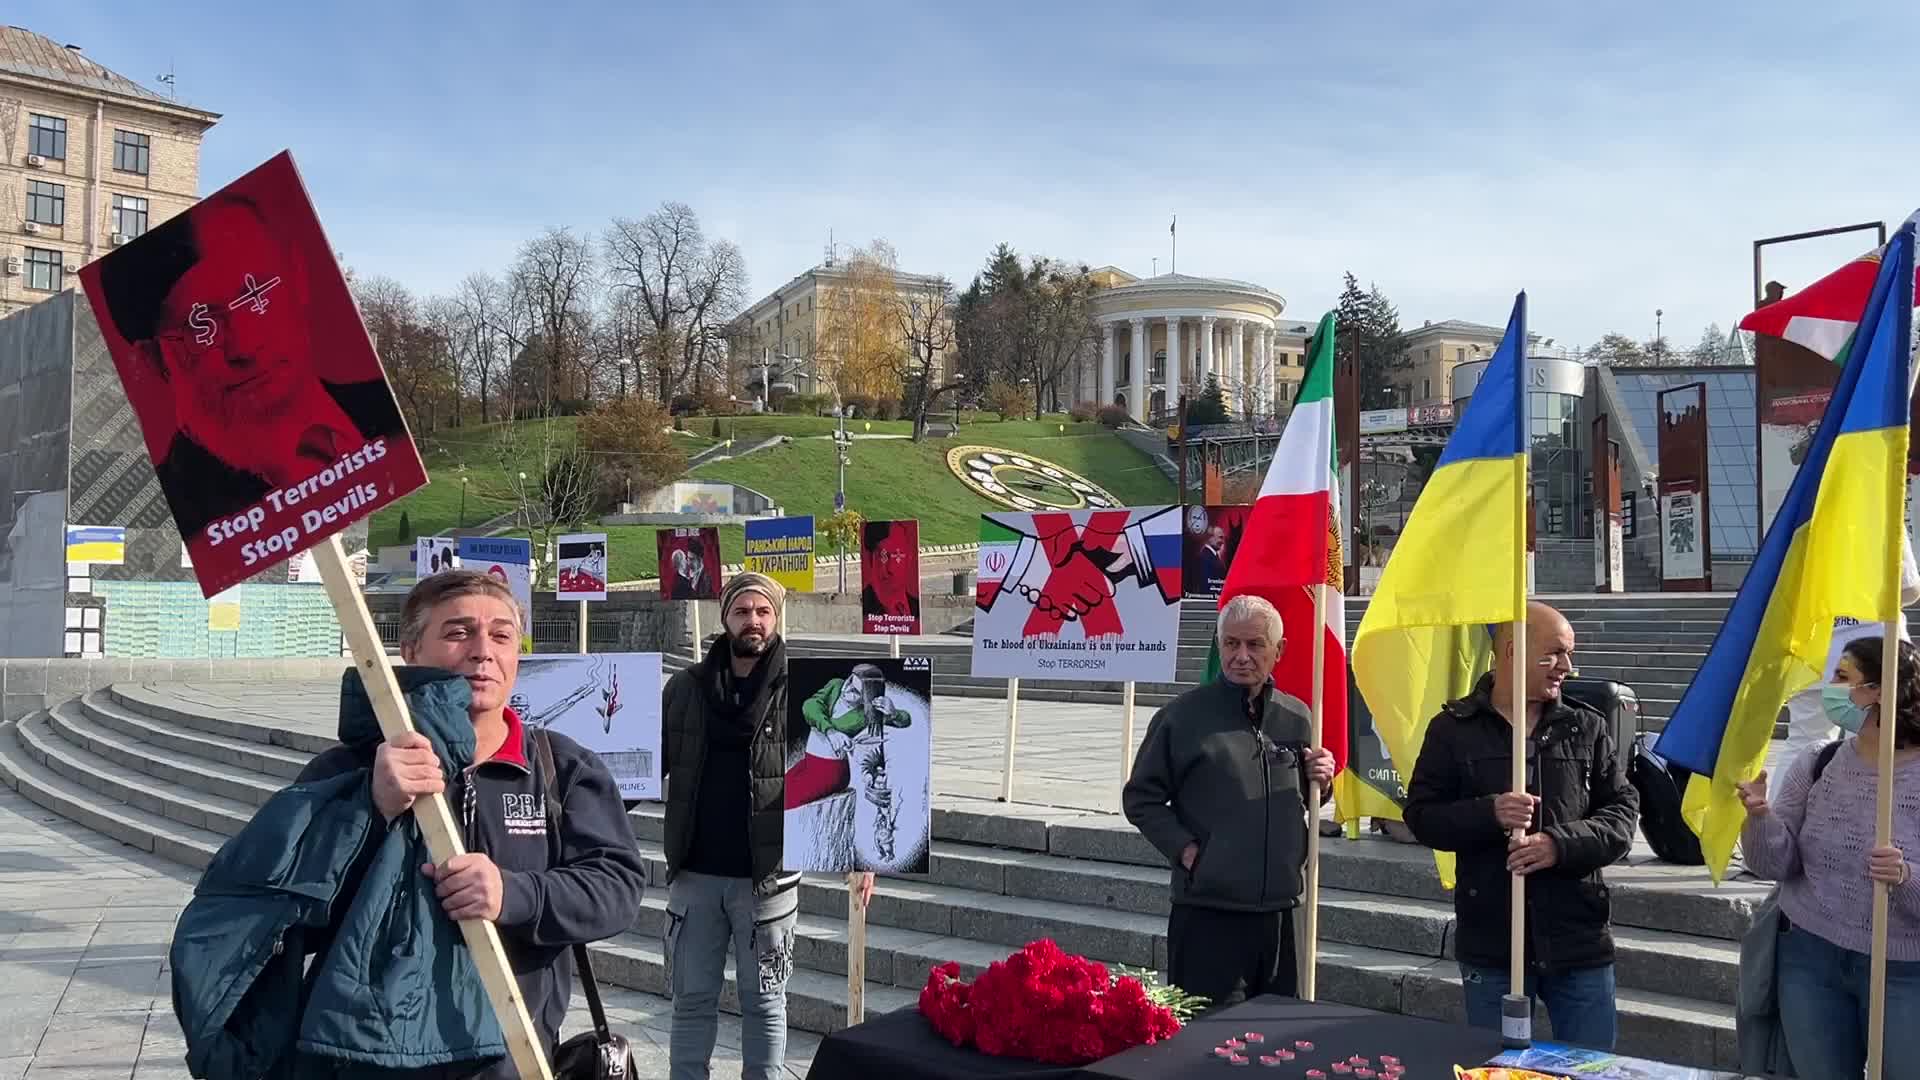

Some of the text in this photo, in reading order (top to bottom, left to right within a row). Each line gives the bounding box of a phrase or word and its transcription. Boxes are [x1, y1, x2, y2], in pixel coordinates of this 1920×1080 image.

[207, 439, 387, 546] Stop Terrorists
[241, 482, 378, 566] Stop Devils
[868, 613, 915, 623] Stop Terrorists
[873, 624, 910, 632] Stop Devils
[983, 638, 1167, 654] The blood of Ukrainians is on your hands
[1038, 658, 1106, 670] Stop TERRORISM
